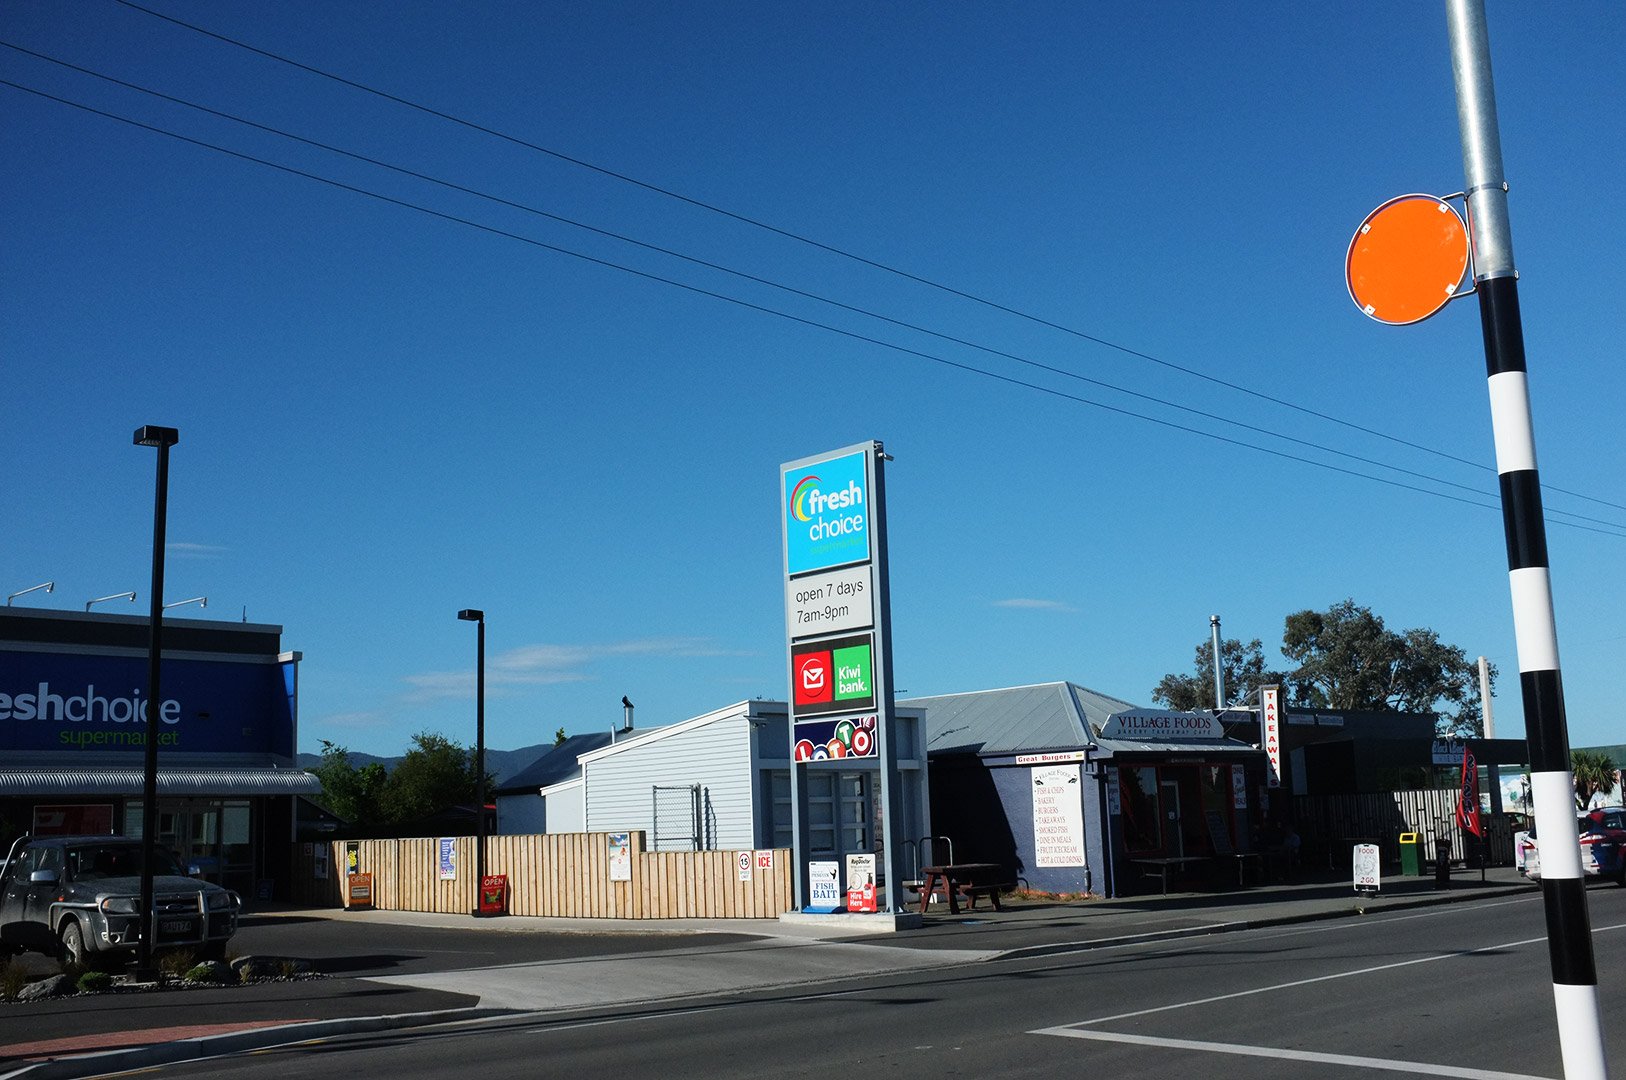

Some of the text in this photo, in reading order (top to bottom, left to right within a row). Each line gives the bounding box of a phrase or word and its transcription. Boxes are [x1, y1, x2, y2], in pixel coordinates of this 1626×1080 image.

[808, 480, 862, 515] fresh
[809, 514, 863, 542] choice
[796, 580, 864, 605] open 7 days
[797, 604, 849, 624] 7am-9pm
[838, 664, 861, 680] Kiwi
[838, 678, 868, 694] bank.
[1117, 716, 1211, 729] VILLAGE FOODS
[798, 724, 870, 761] LOTTO
[1267, 692, 1278, 786] TAKEAWAYS
[1041, 753, 1072, 762] Burgers
[740, 857, 749, 866] 15
[758, 856, 771, 868] ICE
[351, 875, 370, 883] OPEN
[484, 877, 504, 886] OPEN
[813, 890, 838, 899] BAIT
